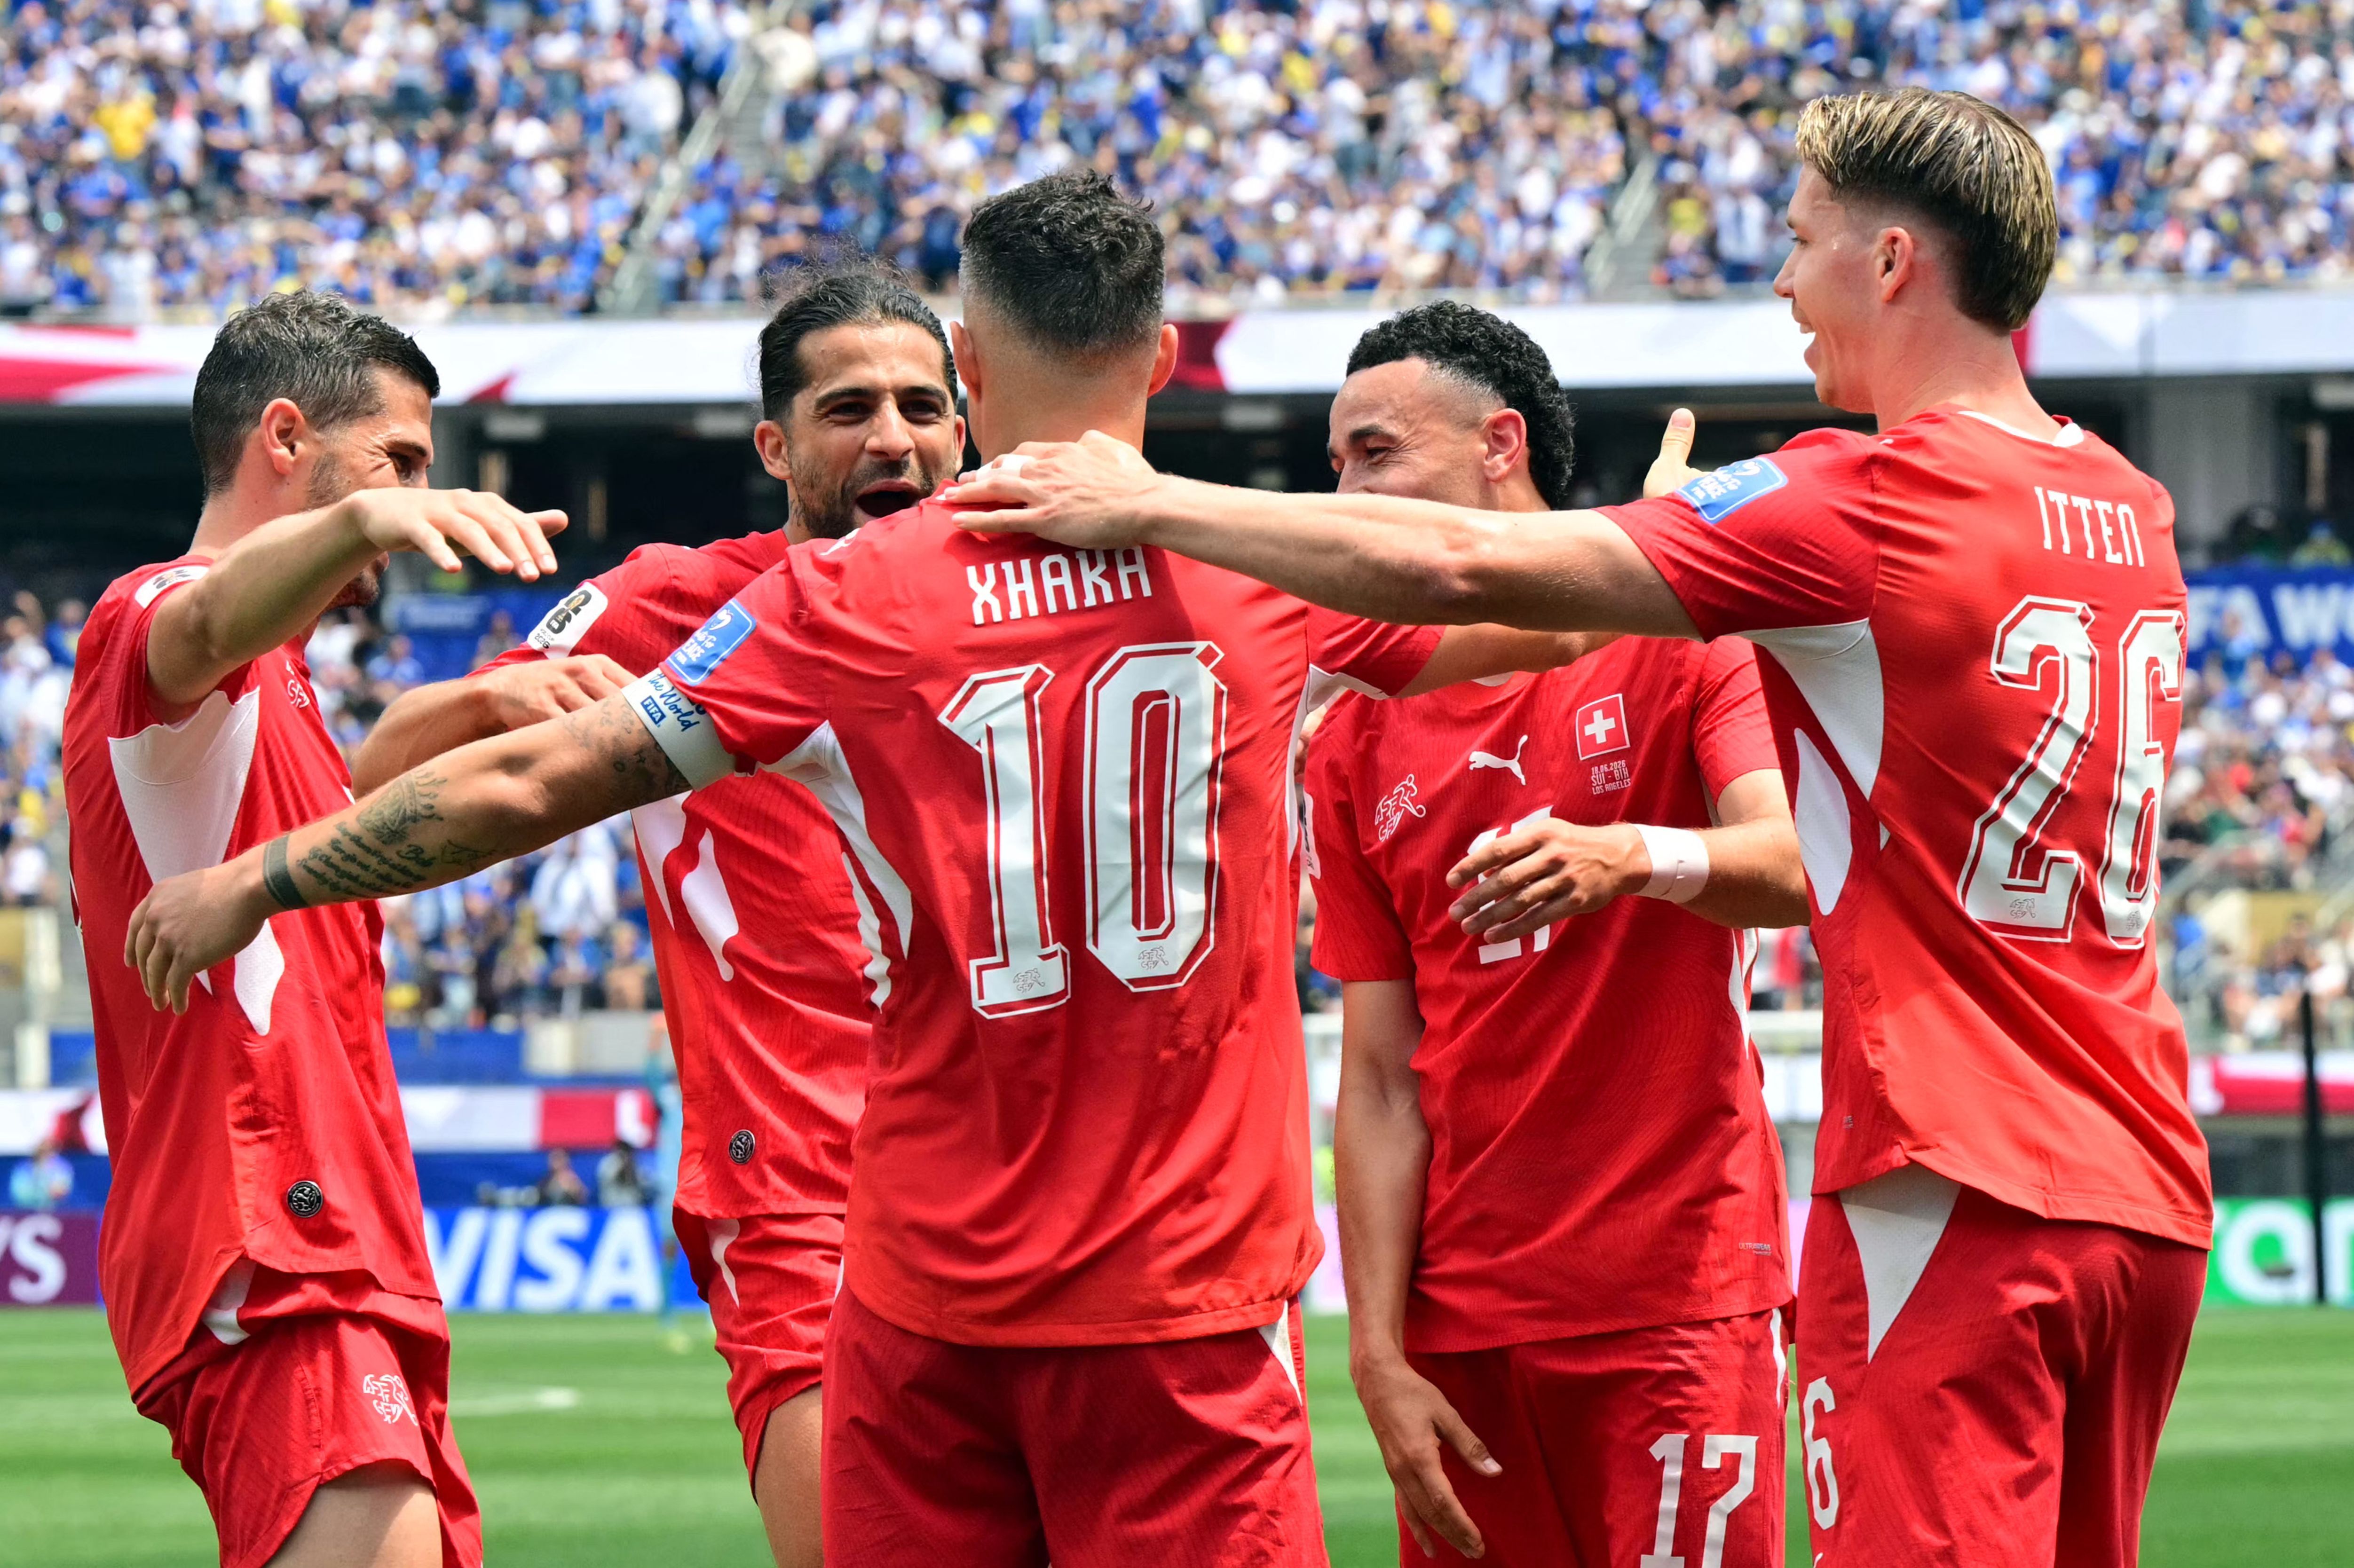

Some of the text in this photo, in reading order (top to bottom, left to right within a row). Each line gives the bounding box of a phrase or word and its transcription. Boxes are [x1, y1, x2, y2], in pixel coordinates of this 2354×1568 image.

[2034, 486, 2145, 567] ITTEN
[966, 545, 1153, 625] XHAKA
[682, 638, 705, 662] EACE
[642, 698, 663, 723] FIFA
[648, 672, 666, 691] the
[659, 686, 700, 732] World
[1591, 760, 1626, 775] 18.06.2026
[1591, 772, 1605, 787] SUI
[1614, 767, 1629, 780] BIH
[1592, 779, 1631, 795] LOS ANGELES
[1957, 594, 2186, 949] 26
[937, 641, 1228, 1019] 10
[424, 1206, 664, 1312] VISA
[1803, 1376, 1839, 1530] 6
[1640, 1434, 1760, 1568] 17
